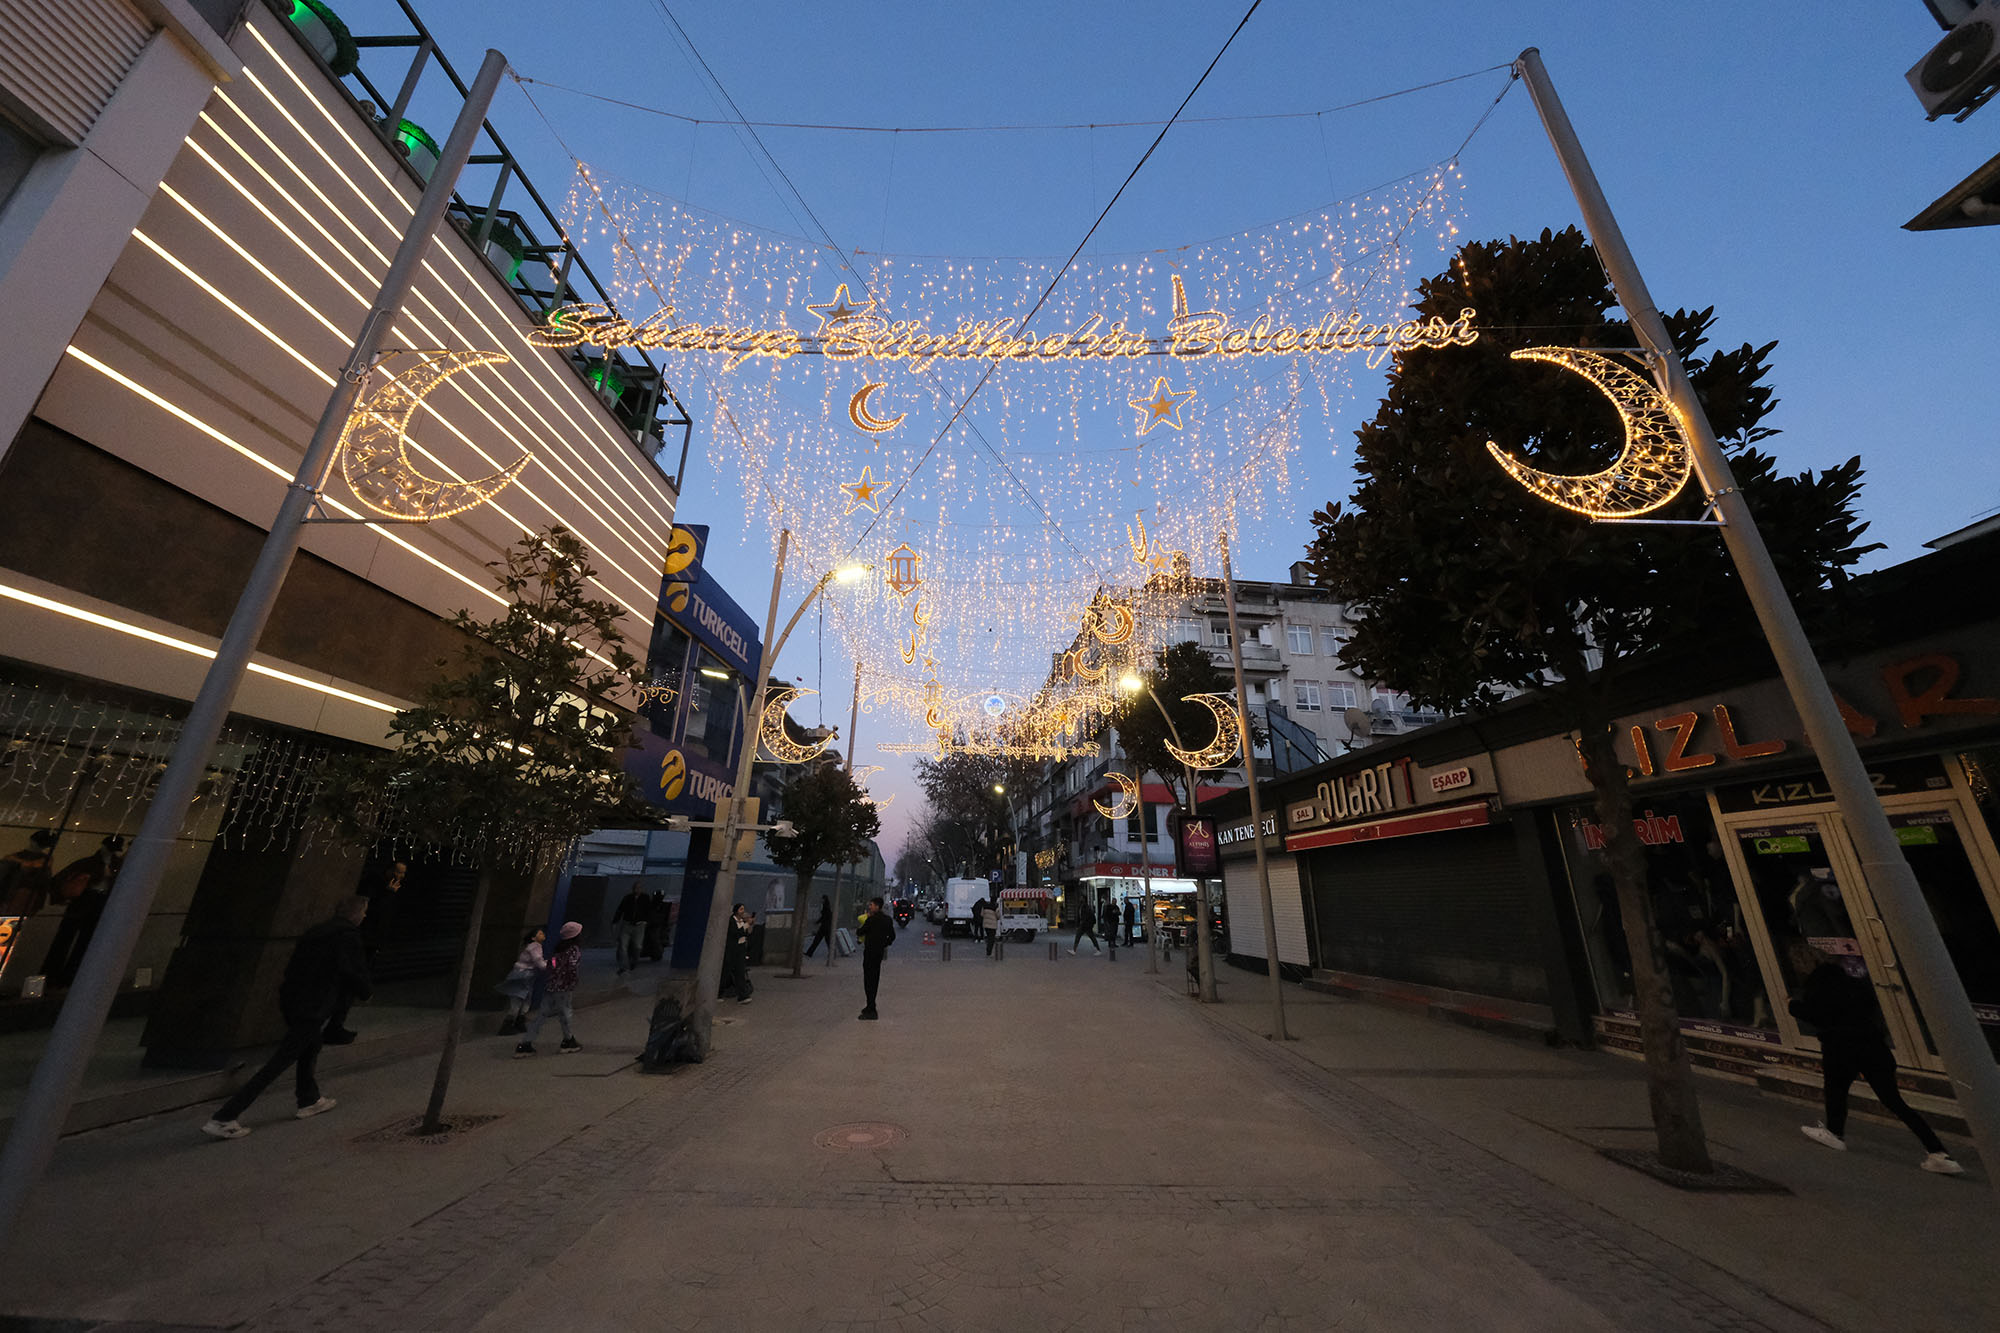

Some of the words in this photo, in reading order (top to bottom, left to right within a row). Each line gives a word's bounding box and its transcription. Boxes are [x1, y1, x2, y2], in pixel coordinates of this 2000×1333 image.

[528, 302, 801, 373] Sakarya
[1168, 306, 1479, 370] Belediyesi
[692, 593, 749, 663] TURKCELL
[1432, 770, 1468, 793] EŞARP
[1217, 828, 1234, 846] KAN
[1233, 815, 1276, 842] TENEECİ
[1296, 809, 1310, 821] ŞAL
[1580, 809, 1686, 851] İNRİM
[1693, 1024, 1723, 1034] WORLD
[1735, 1031, 1767, 1041] WORLD
